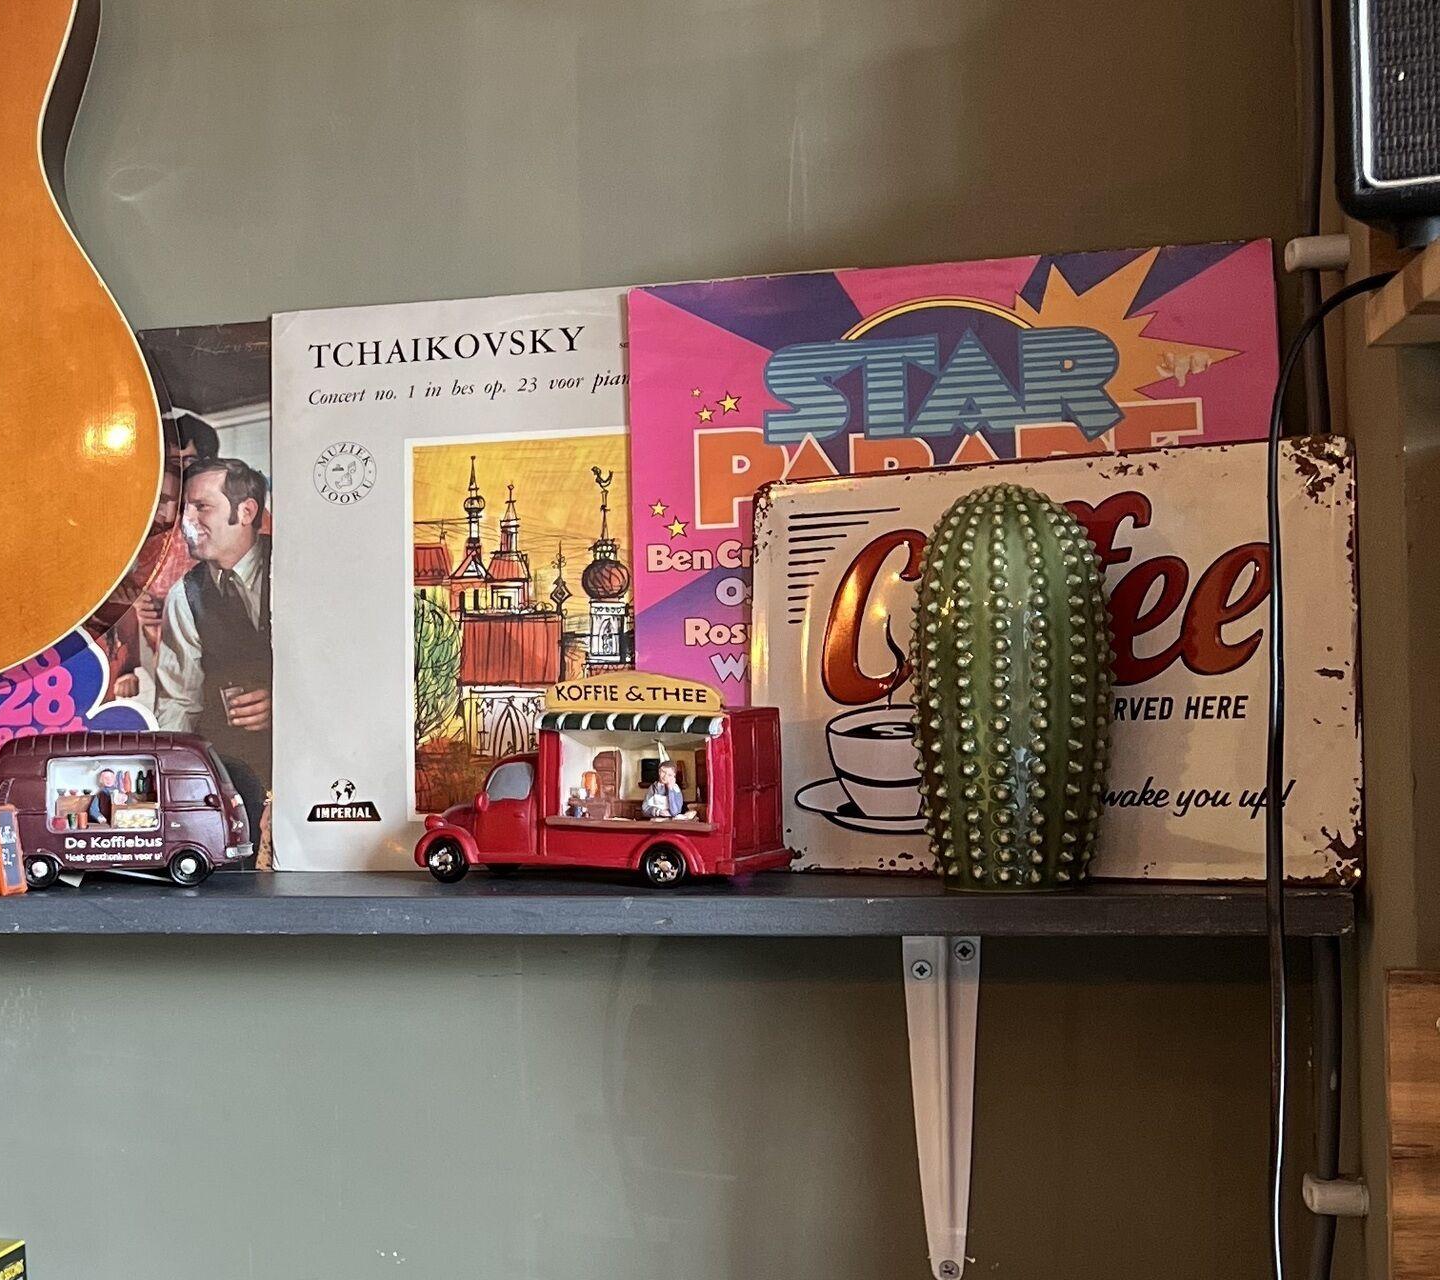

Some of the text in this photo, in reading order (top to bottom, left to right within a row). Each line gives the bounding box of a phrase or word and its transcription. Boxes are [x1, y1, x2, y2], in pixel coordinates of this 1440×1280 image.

[308, 325, 585, 369] TCHAIKOVSKY
[308, 388, 366, 406] Concert
[374, 387, 398, 401] no.
[409, 385, 415, 399] 1
[424, 381, 442, 398] in
[451, 379, 475, 396] bes
[484, 380, 507, 401] op.
[517, 377, 538, 392] 23
[549, 377, 584, 390] voor
[763, 325, 1126, 445] STAR
[317, 443, 373, 467] MUZIEK
[320, 484, 362, 504] VOOR
[646, 543, 713, 573] Ben
[555, 685, 708, 703] KOFFIE & THEE
[1113, 695, 1249, 721] RVED HERE
[315, 806, 373, 819] IMPERIAL
[1173, 788, 1232, 818] you
[64, 835, 163, 849] De Koffiebus
